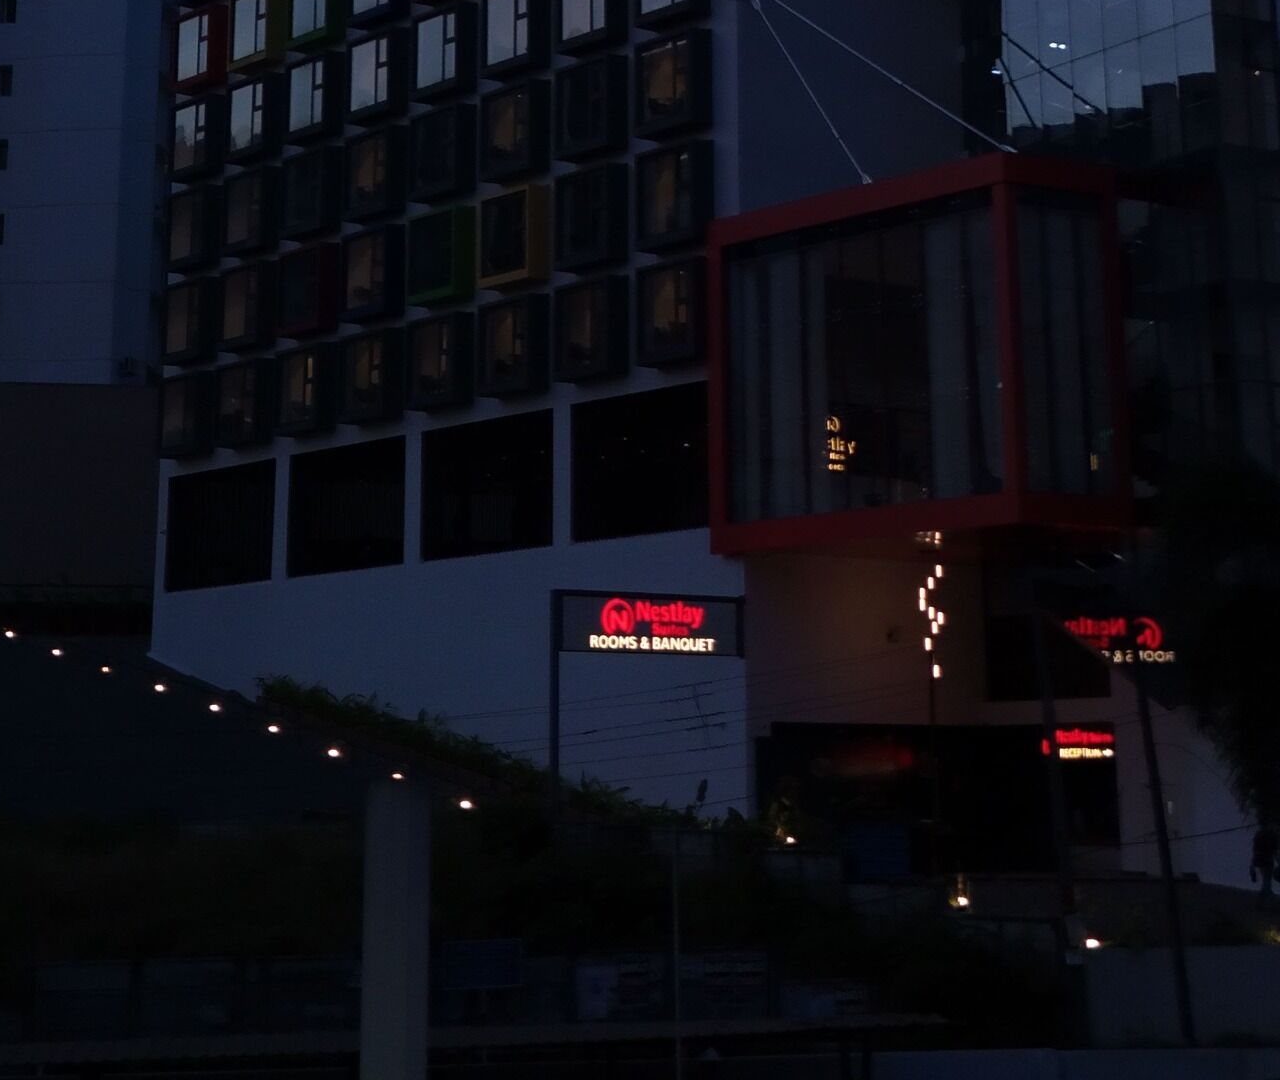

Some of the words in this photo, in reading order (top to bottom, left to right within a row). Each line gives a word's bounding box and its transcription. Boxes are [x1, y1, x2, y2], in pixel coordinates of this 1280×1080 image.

[635, 601, 704, 630] Nestlay
[589, 634, 638, 650] ROOMS
[640, 636, 651, 651] &
[652, 636, 715, 652] BANQUET
